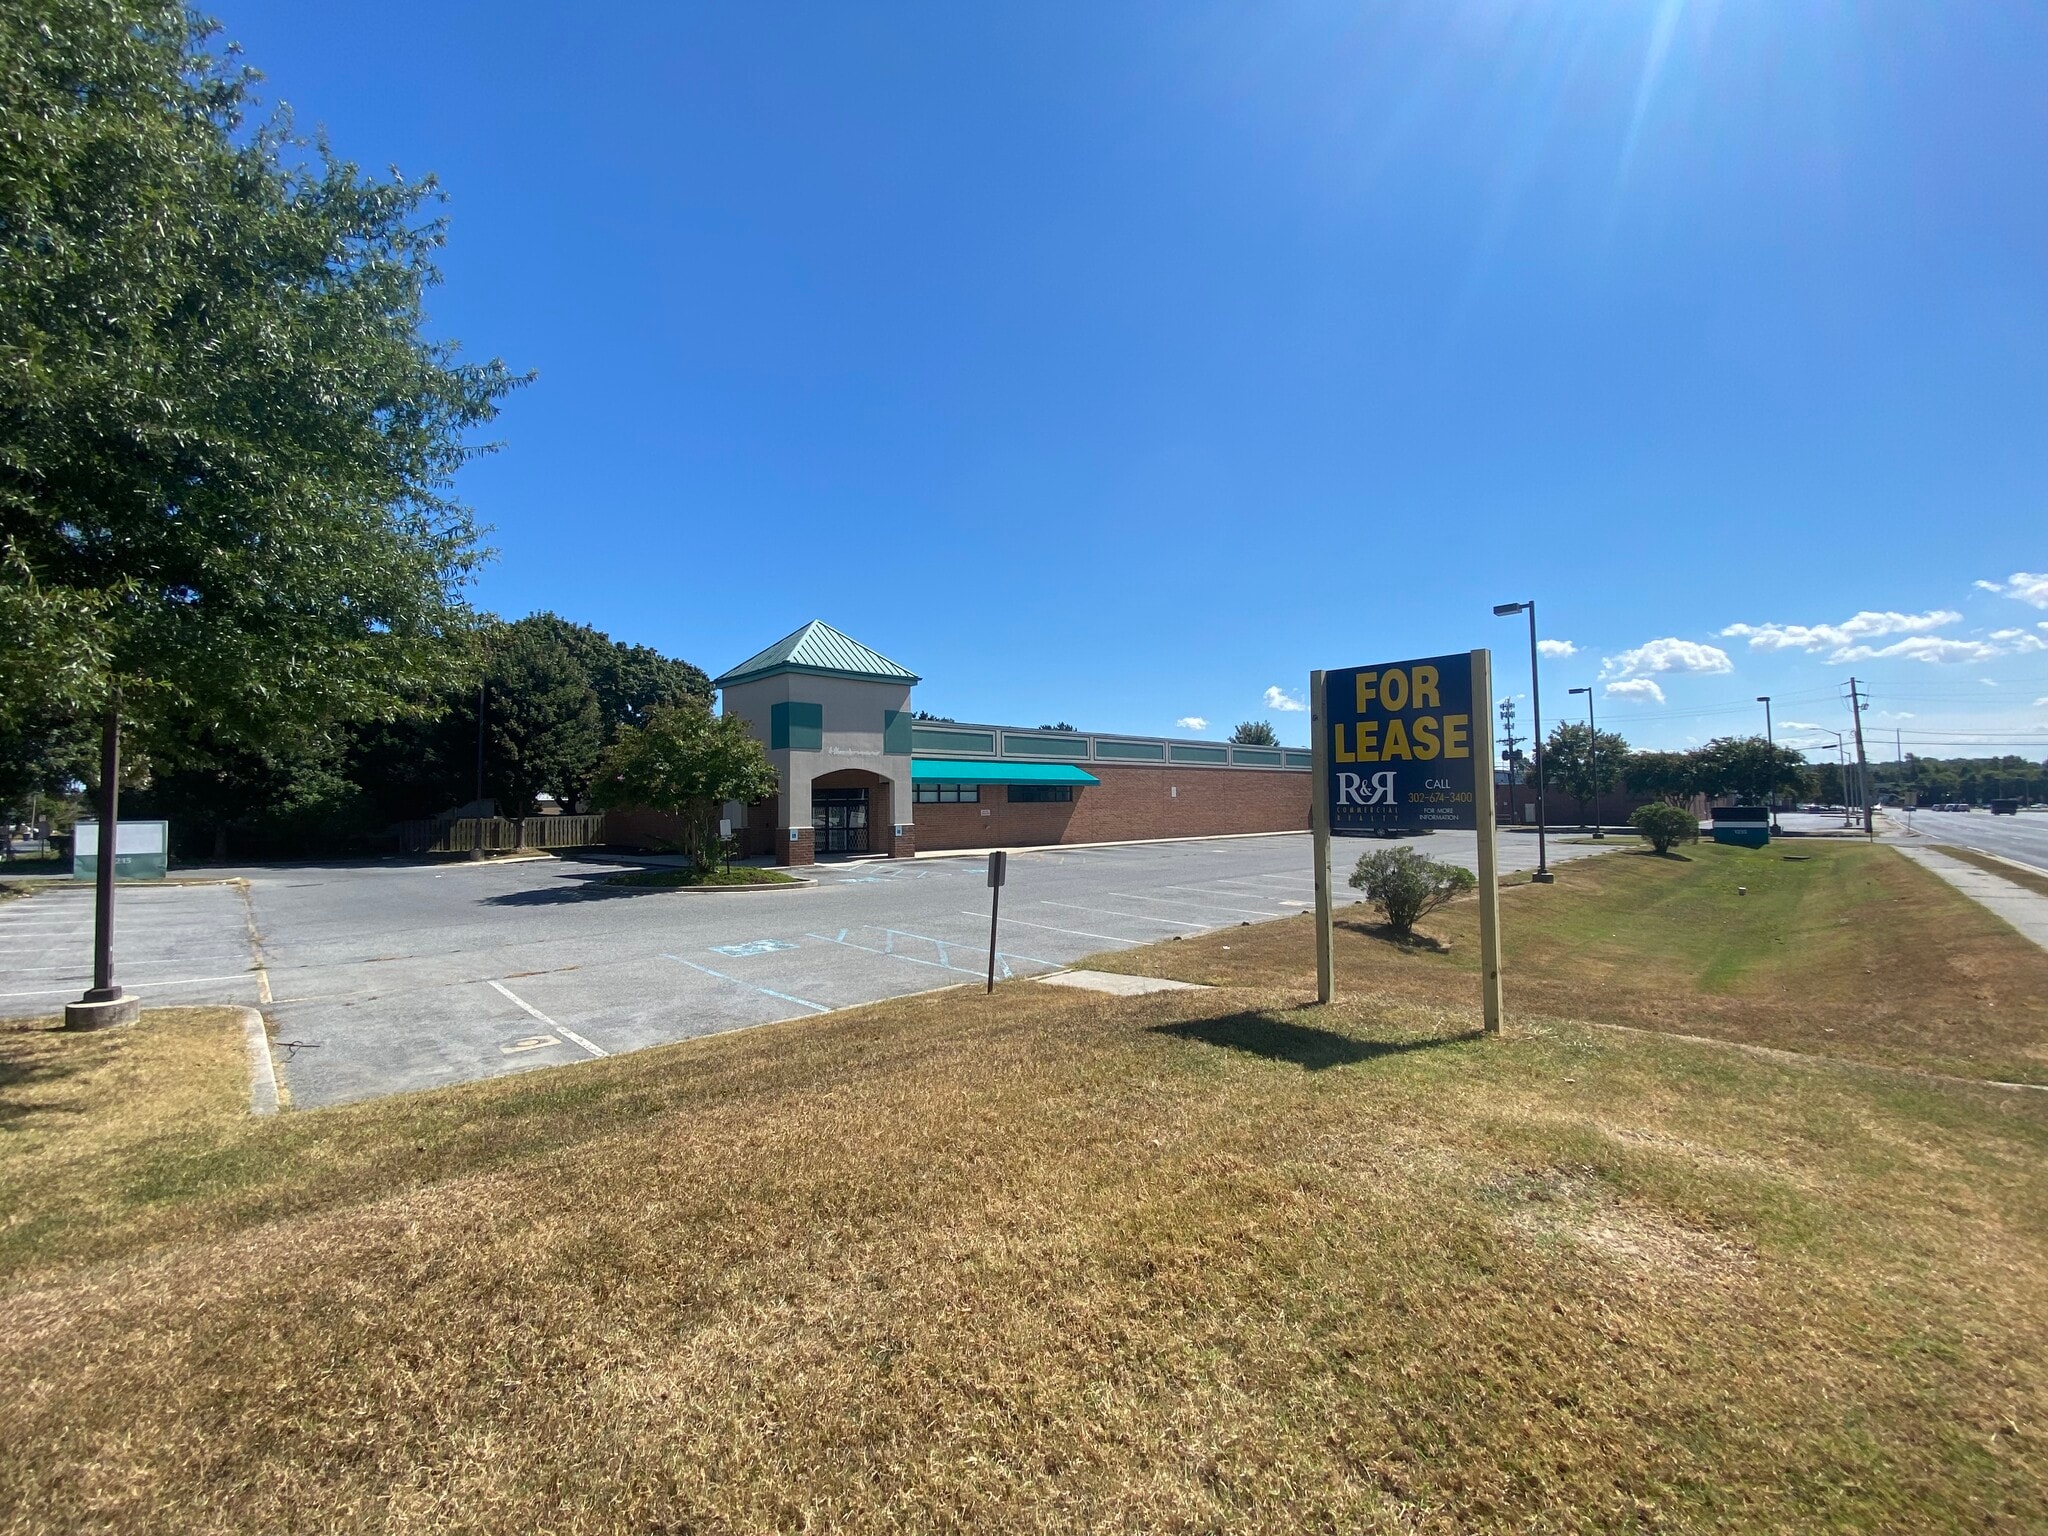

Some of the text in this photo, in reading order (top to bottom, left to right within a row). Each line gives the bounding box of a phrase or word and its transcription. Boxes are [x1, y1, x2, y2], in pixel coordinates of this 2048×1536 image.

[1356, 665, 1440, 714] FOR
[1334, 714, 1470, 763] LEASE
[1425, 779, 1451, 789] CALL
[1408, 792, 1473, 803] 302-674-3400
[1336, 806, 1398, 814] COMMERCIAL
